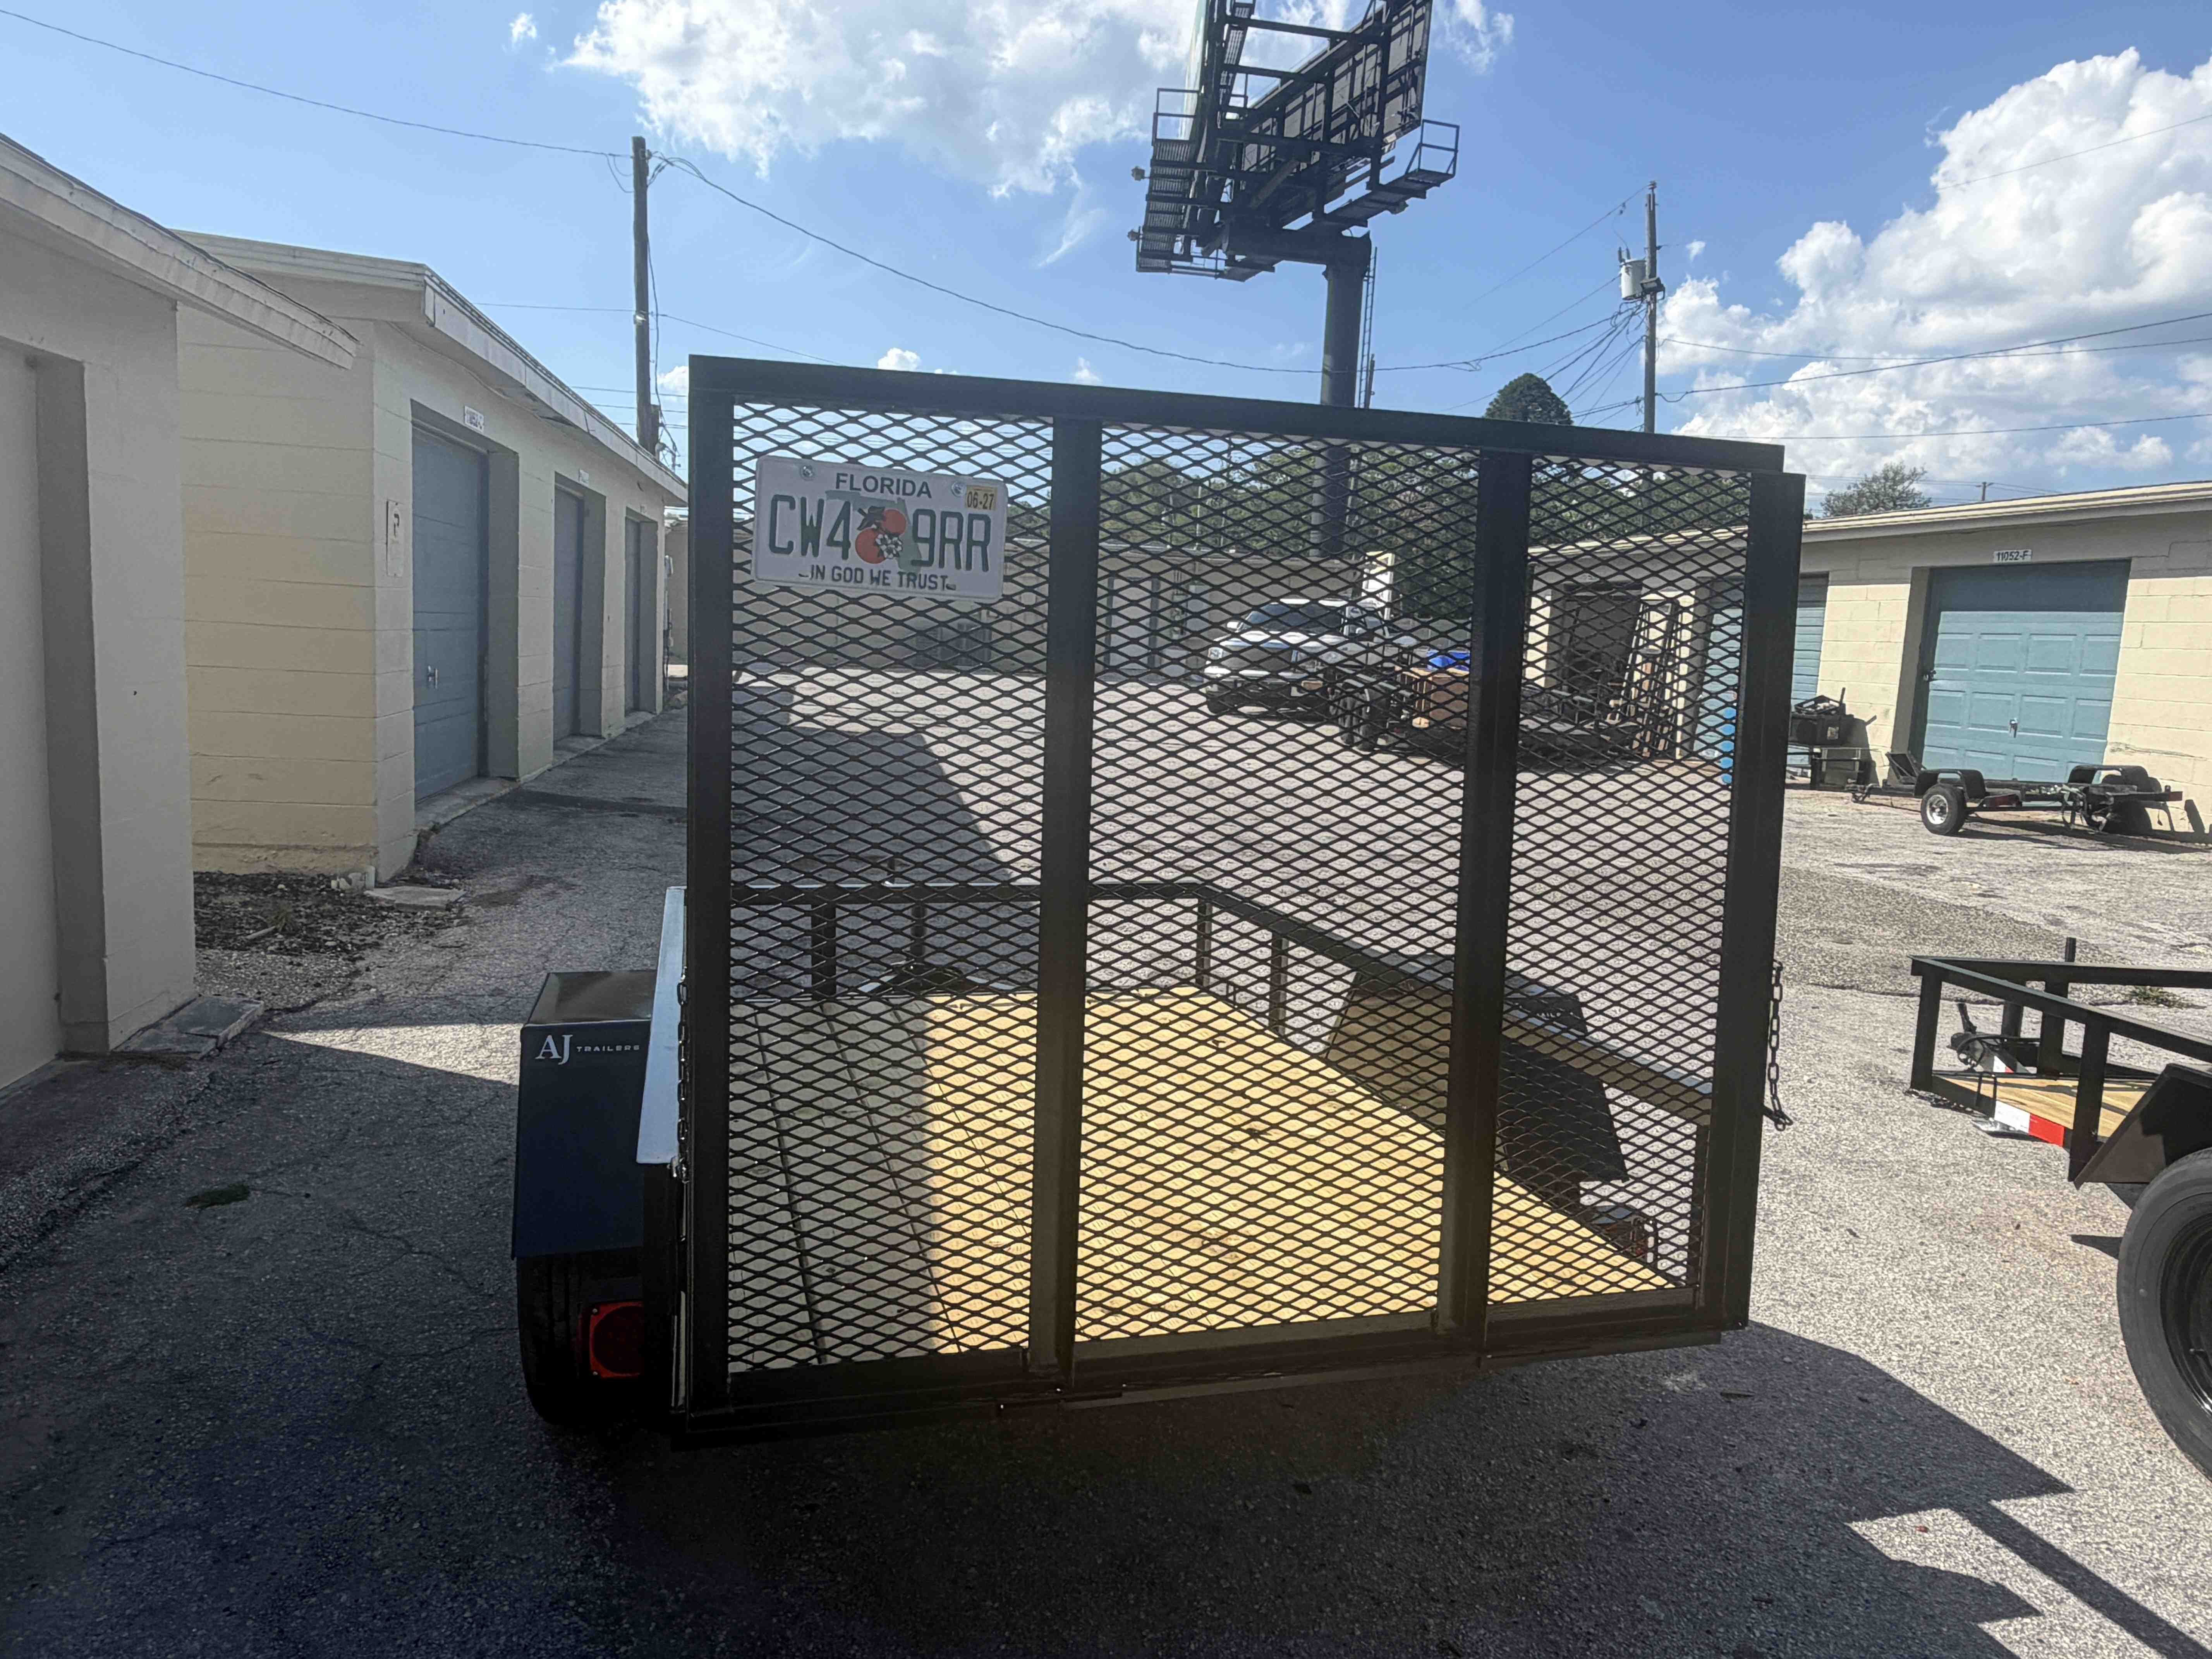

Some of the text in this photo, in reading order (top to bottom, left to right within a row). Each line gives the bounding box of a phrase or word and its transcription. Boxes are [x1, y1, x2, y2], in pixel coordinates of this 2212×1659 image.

[835, 473, 932, 498] FLORIDA
[810, 565, 948, 591] IN GOD WE TRUST
[535, 1035, 573, 1065] AJ
